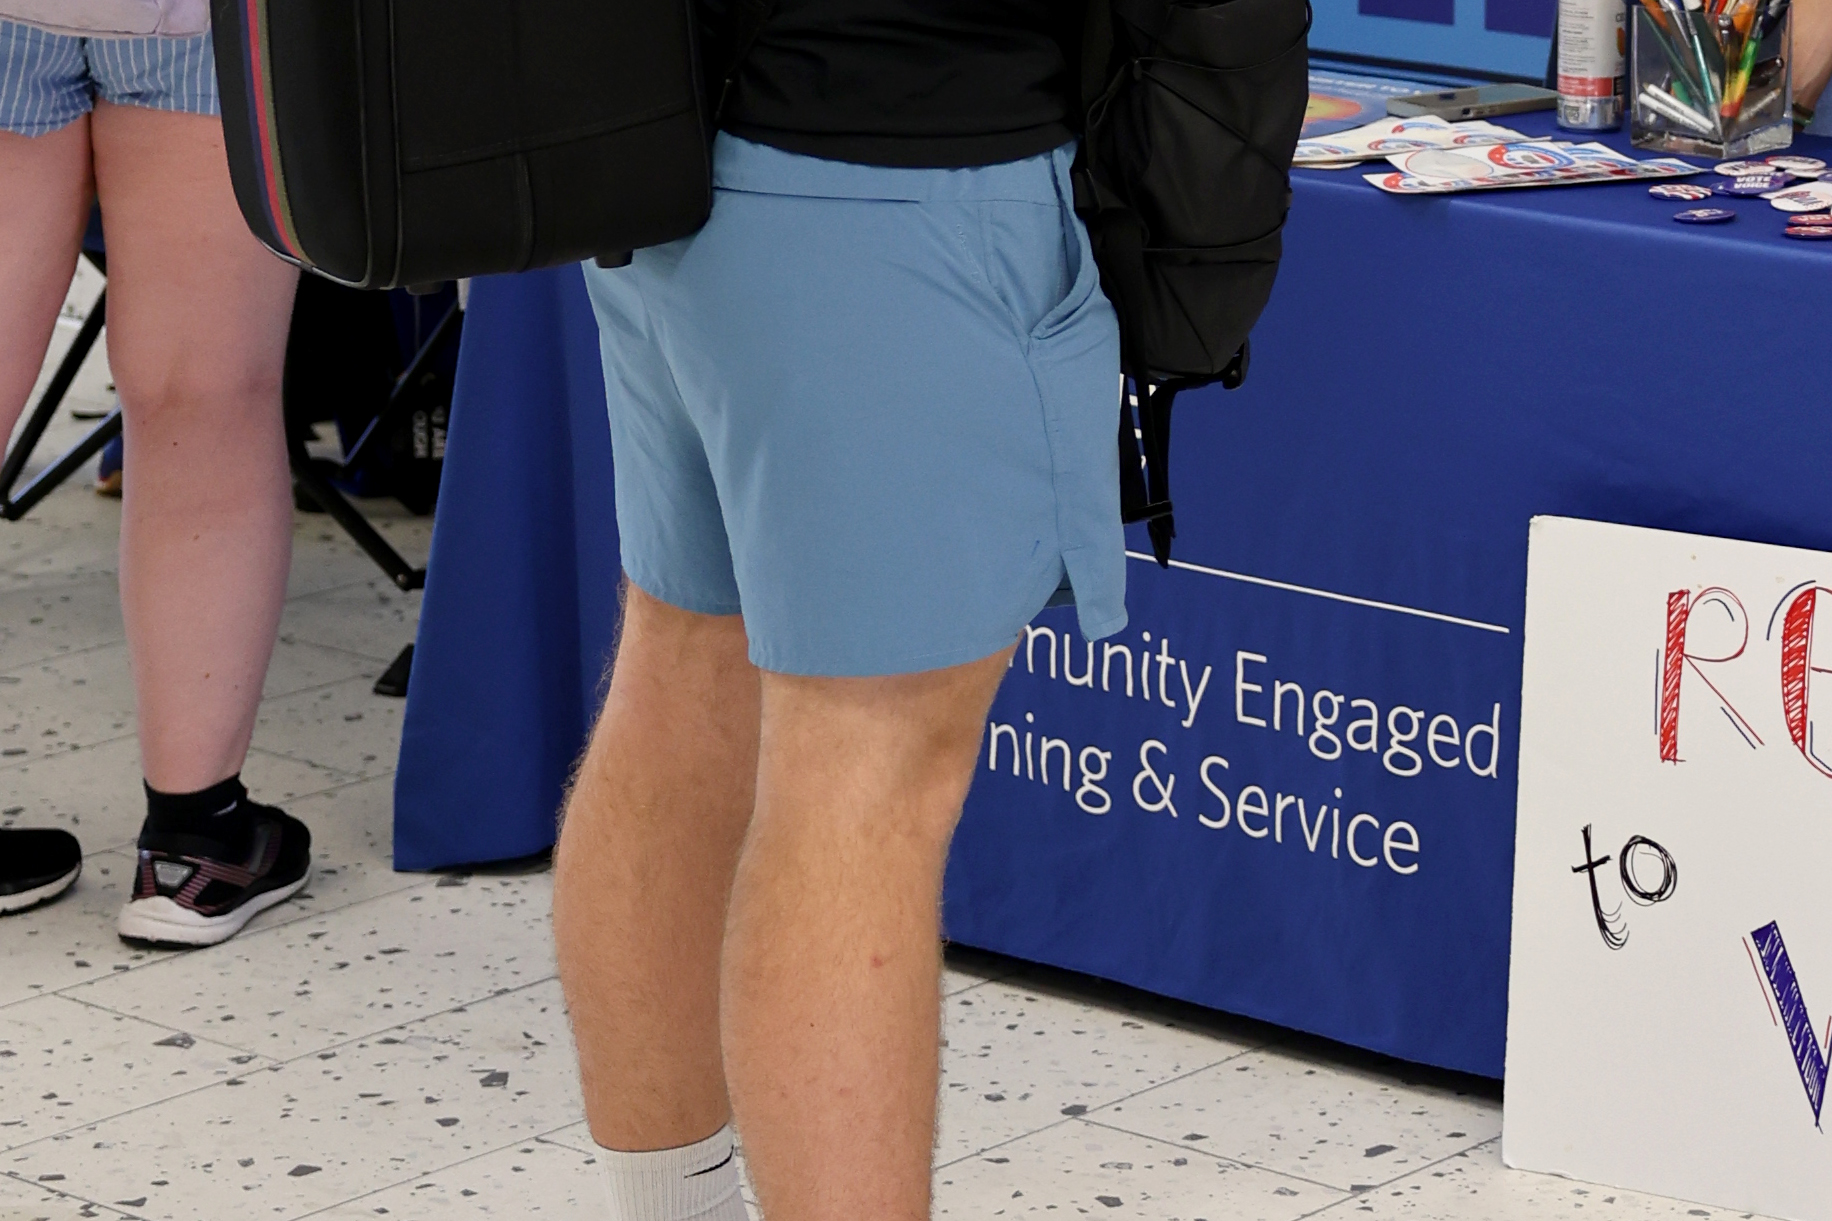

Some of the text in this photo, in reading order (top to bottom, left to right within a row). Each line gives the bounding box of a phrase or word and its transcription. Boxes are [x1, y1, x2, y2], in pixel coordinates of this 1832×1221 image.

[1235, 649, 1501, 779] Engaged
[988, 712, 1420, 875] ning & Service
[1571, 823, 1678, 950] to
